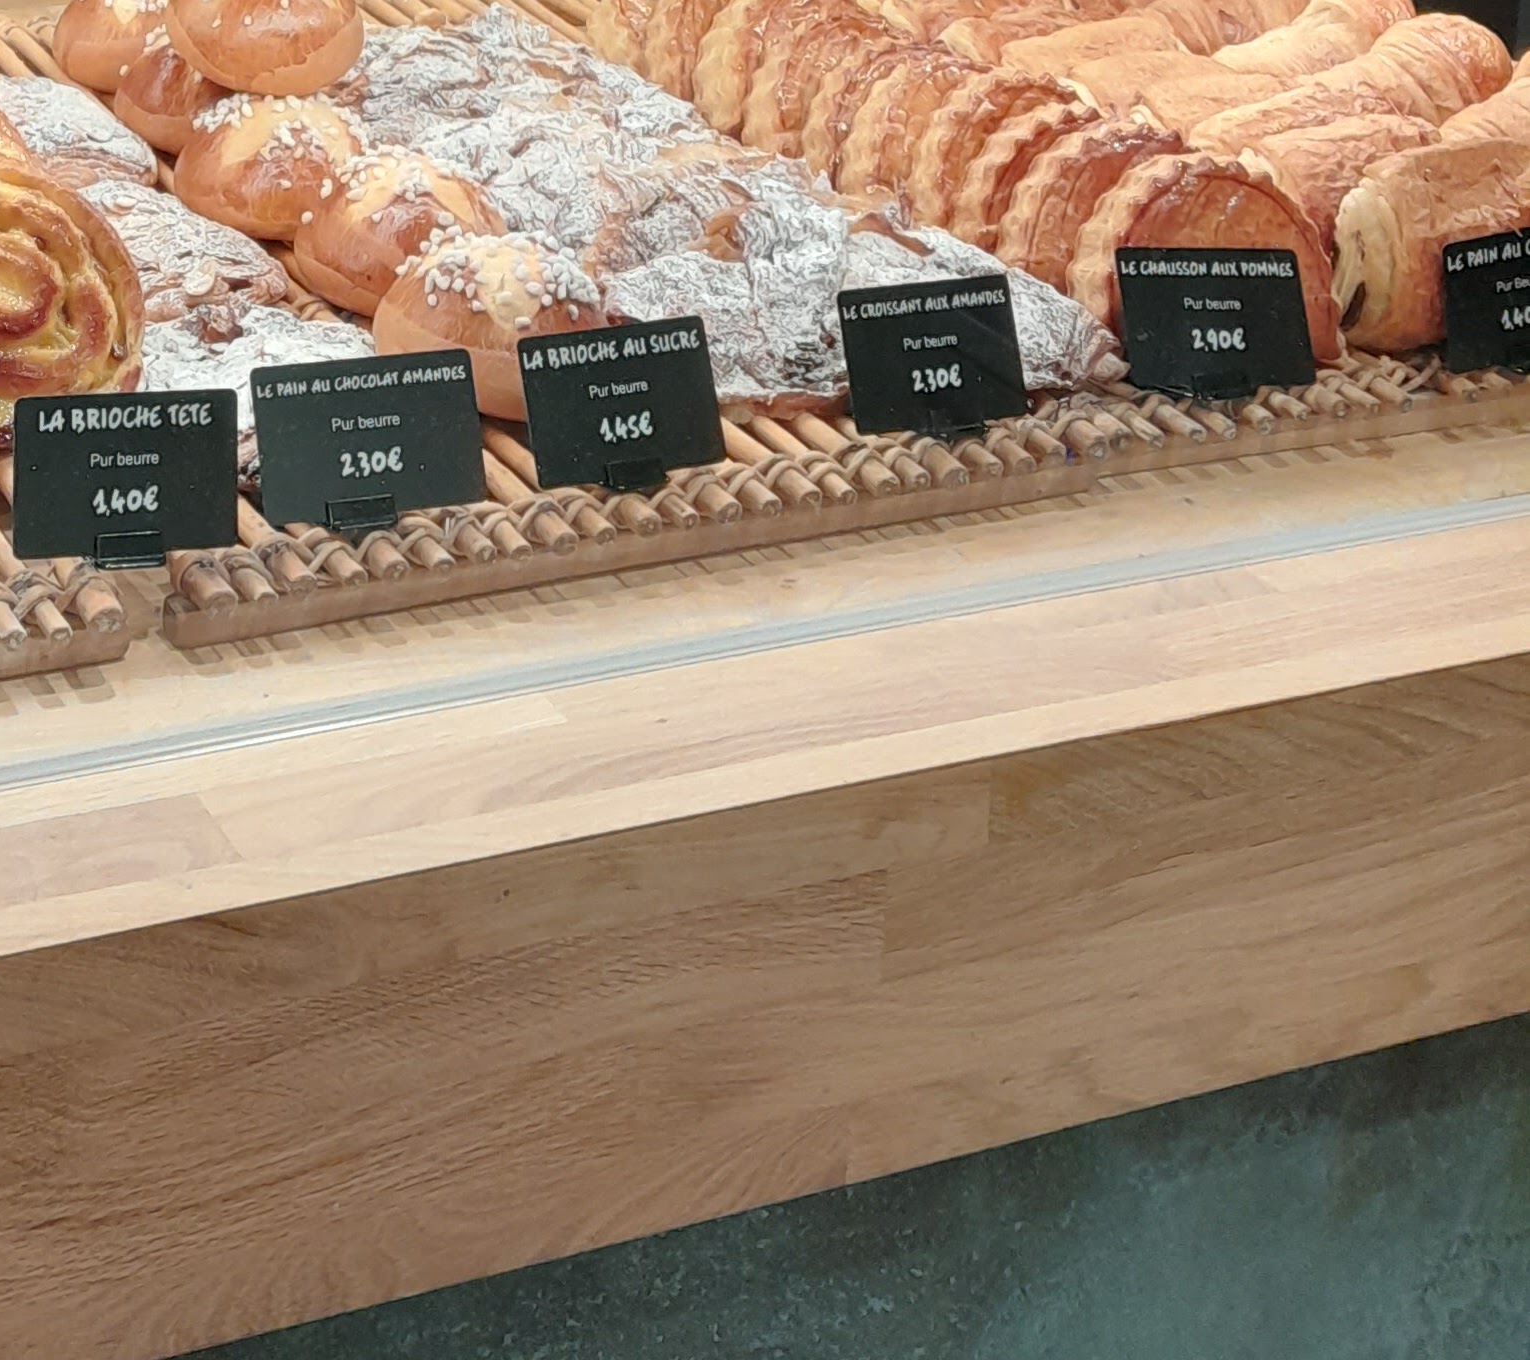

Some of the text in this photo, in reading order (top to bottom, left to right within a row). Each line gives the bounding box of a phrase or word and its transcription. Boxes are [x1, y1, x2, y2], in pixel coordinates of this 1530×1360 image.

[1120, 260, 1294, 278] LE CHAUSSON AUX POMMES
[1447, 253, 1464, 272] LE
[1467, 246, 1498, 268] PAIN
[1502, 241, 1522, 261] AU
[1496, 280, 1513, 293] Pur
[843, 289, 1006, 321] LE CROISSANT AUX AMANDES
[1183, 297, 1242, 311] Pur beurre
[522, 328, 700, 370] LA BRIOCHE AU SUCRE
[903, 335, 958, 351] Pur beurre
[1191, 327, 1247, 352] 2,90€
[256, 365, 466, 399] LE PAIN AU CHOCOLAT AMANDES
[588, 381, 649, 399] Pur beurre
[912, 363, 962, 393] 2,30€
[38, 402, 213, 433] LA BRIOCHE TETE
[331, 413, 401, 432] Pur beurre
[599, 410, 653, 443] 1,45€
[90, 451, 160, 468] Pur beurre
[340, 445, 404, 478] 2,30€
[92, 484, 159, 517] 1,40€
